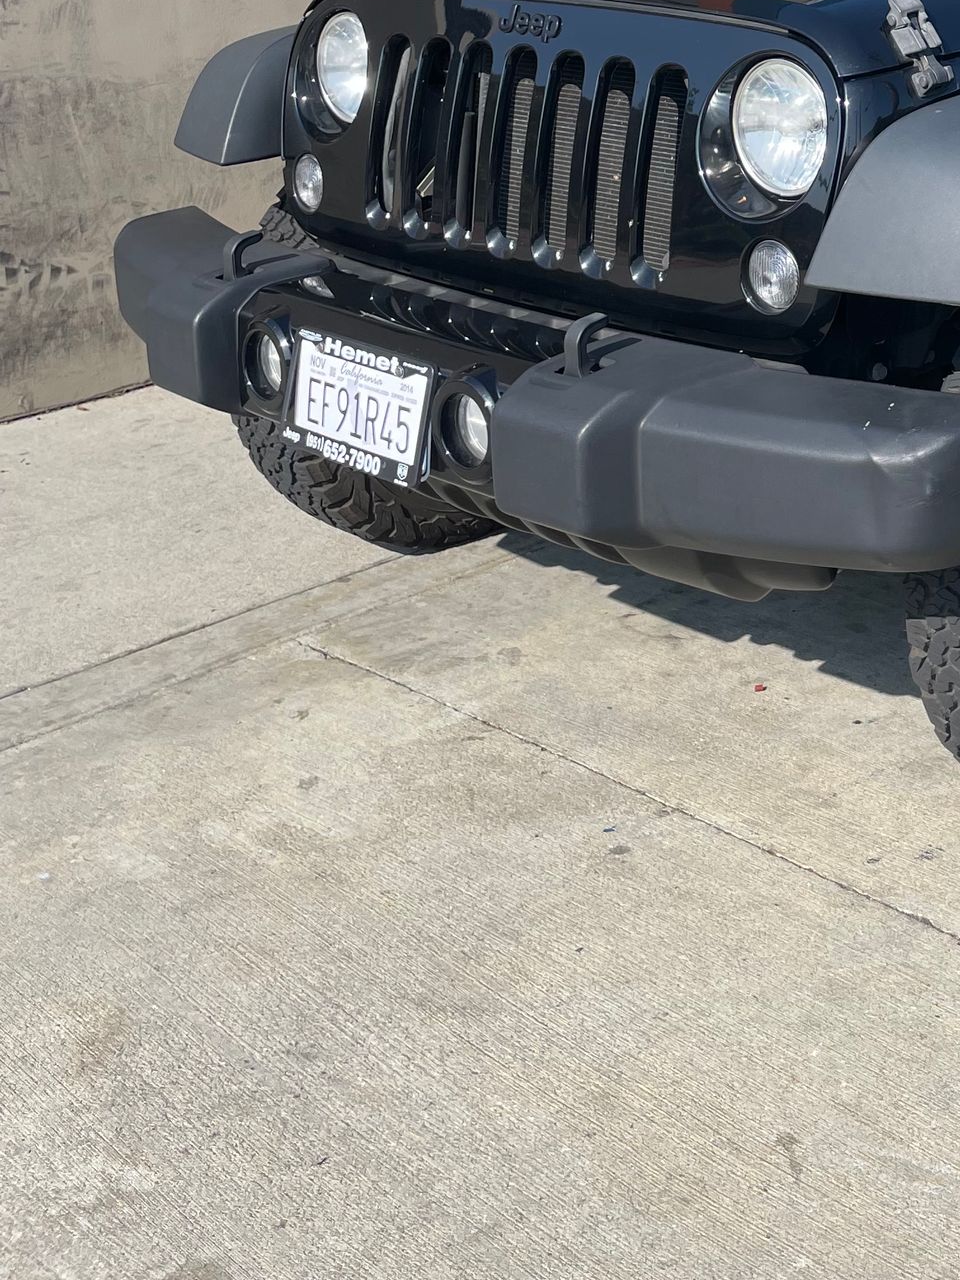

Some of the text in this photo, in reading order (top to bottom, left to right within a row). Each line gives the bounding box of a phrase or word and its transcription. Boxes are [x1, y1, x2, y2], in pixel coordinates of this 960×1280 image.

[499, 4, 562, 43] Jeep
[323, 336, 400, 372] Hemet
[340, 361, 383, 386] California
[306, 376, 411, 455] EF91R45
